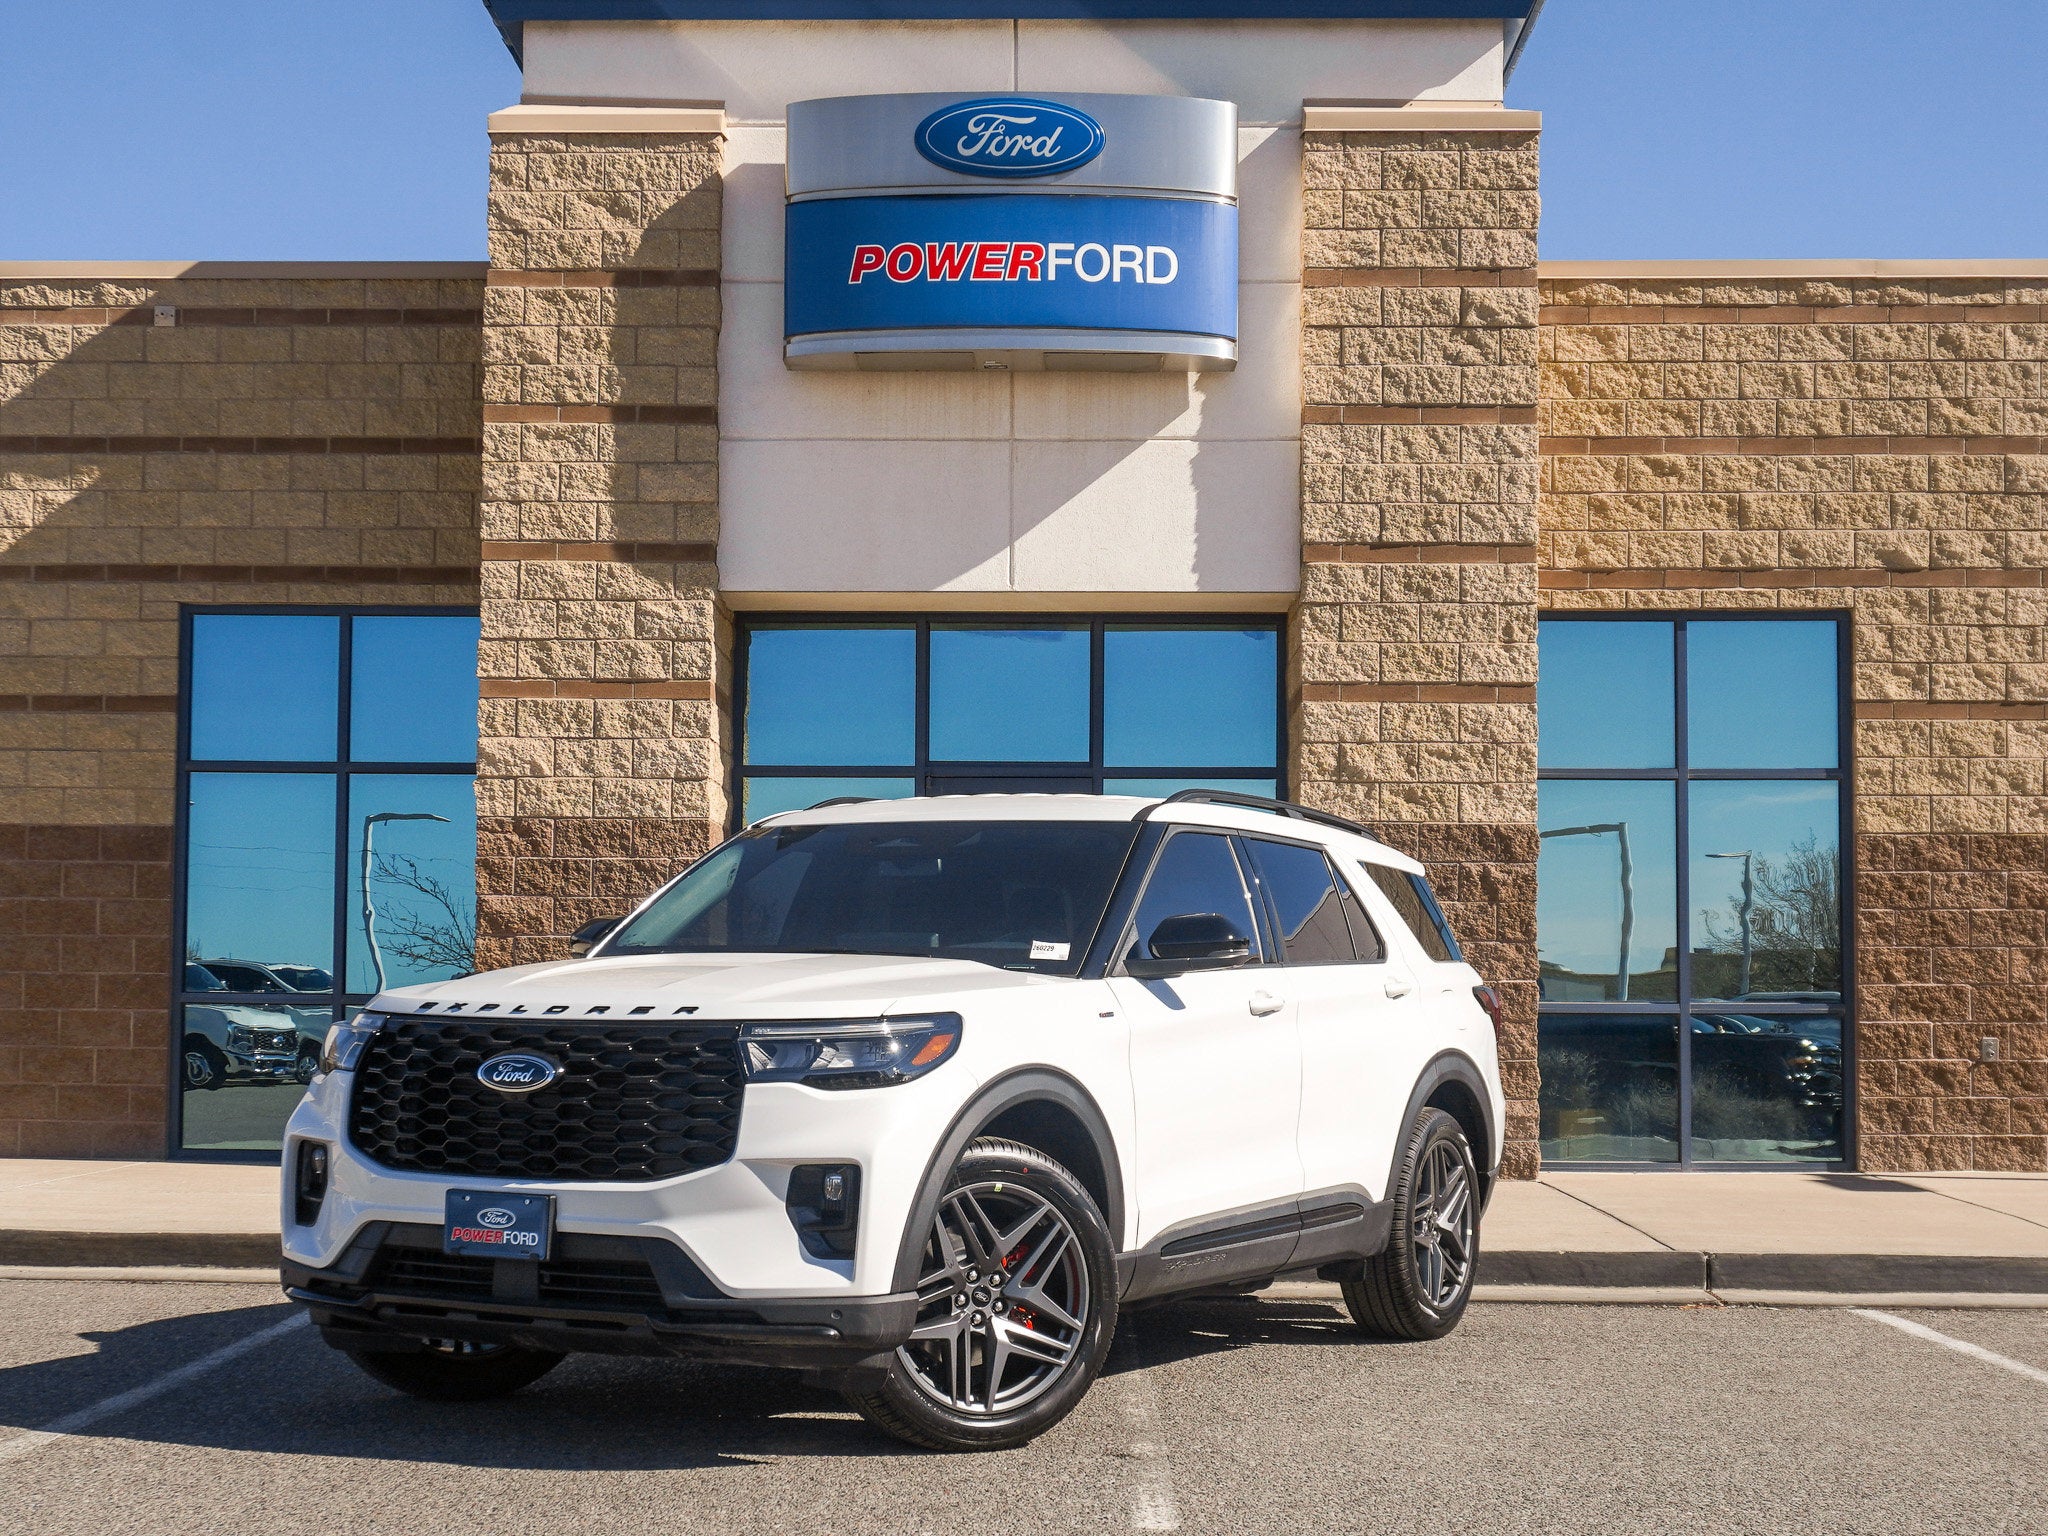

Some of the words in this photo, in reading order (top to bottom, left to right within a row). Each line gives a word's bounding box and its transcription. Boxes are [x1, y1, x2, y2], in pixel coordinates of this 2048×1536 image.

[957, 113, 1064, 158] Ford
[848, 241, 1179, 285] POWERFORD
[415, 1001, 700, 1015] EXPLORER
[492, 1062, 534, 1083] Ford
[484, 1211, 508, 1224] Ford
[451, 1227, 539, 1246] POWERFORD
